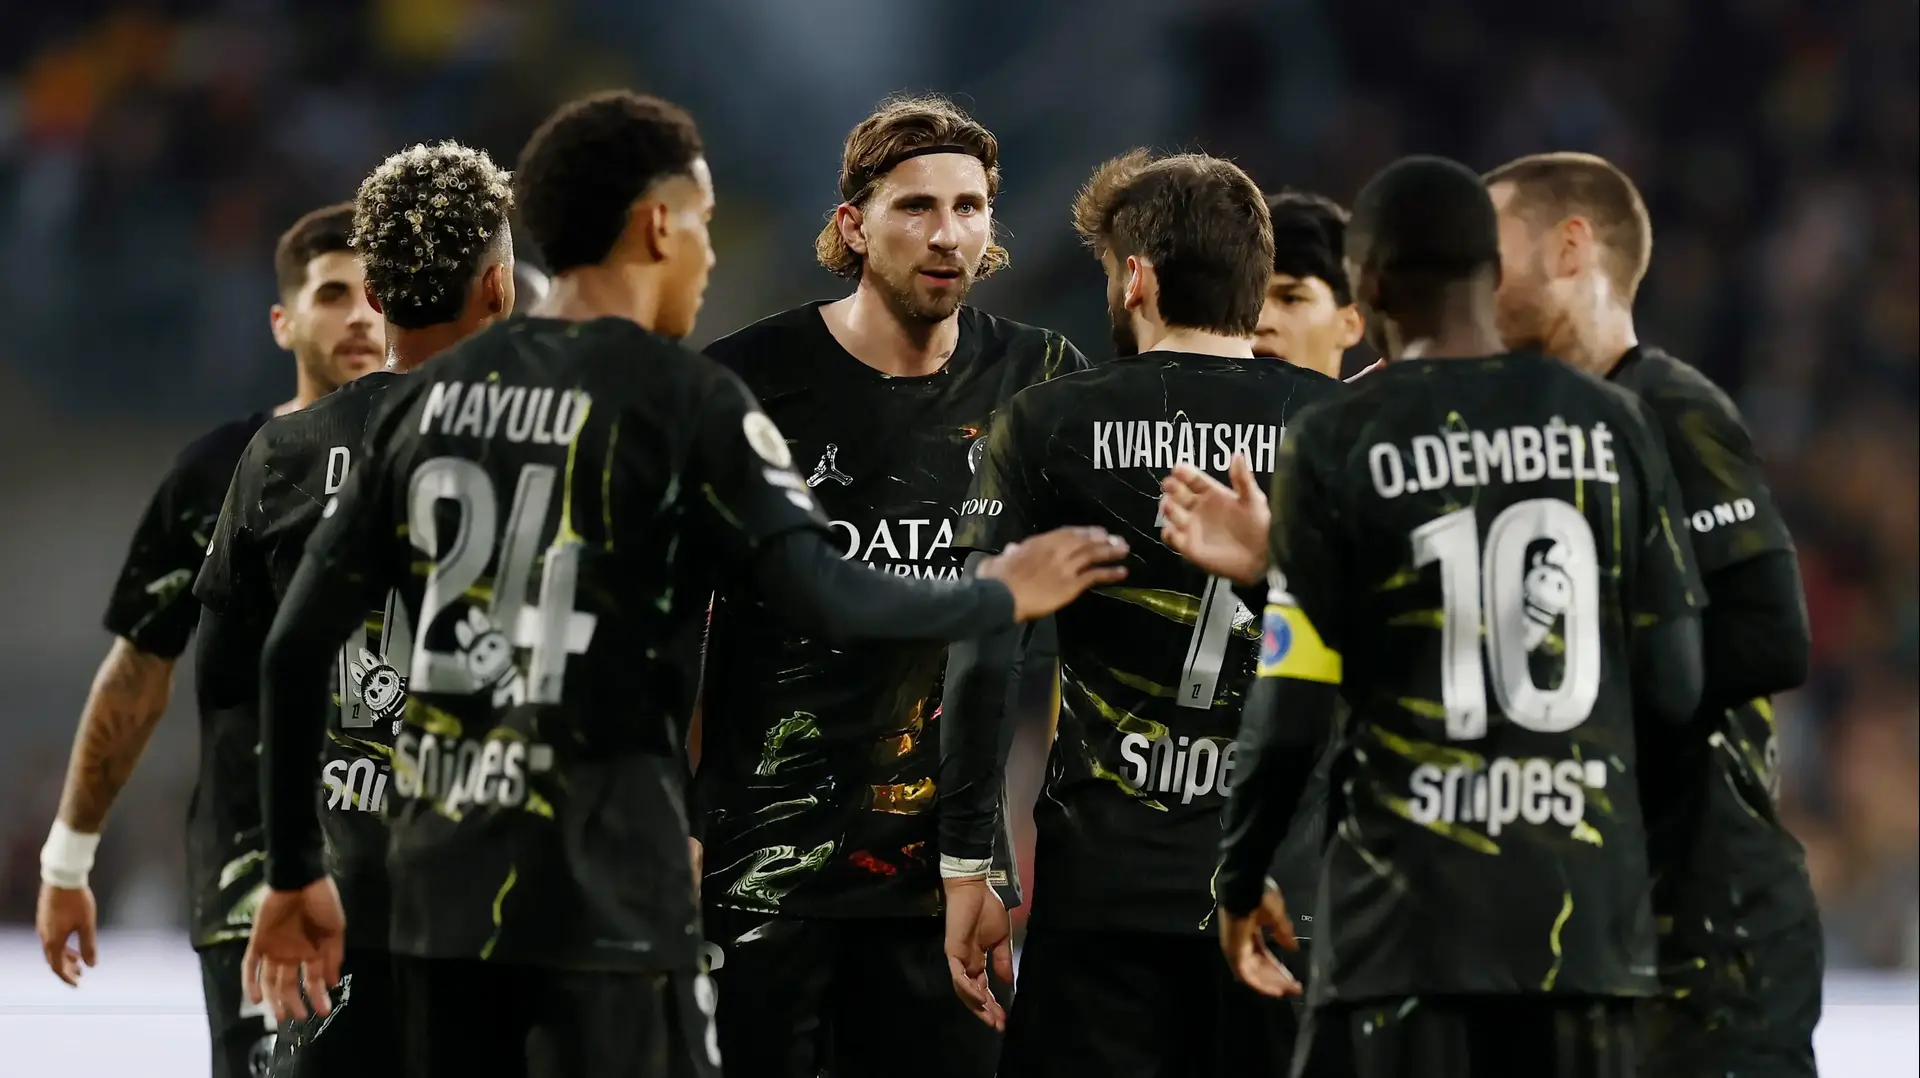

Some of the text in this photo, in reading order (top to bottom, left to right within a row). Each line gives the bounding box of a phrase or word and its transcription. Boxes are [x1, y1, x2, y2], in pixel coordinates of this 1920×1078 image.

[1683, 497, 1756, 533] OND
[407, 456, 598, 705] 24
[1410, 497, 1600, 741] 10
[321, 757, 391, 812] sni
[395, 732, 525, 816] snipes
[1119, 733, 1239, 804] snipe
[1409, 756, 1585, 837] snipes
